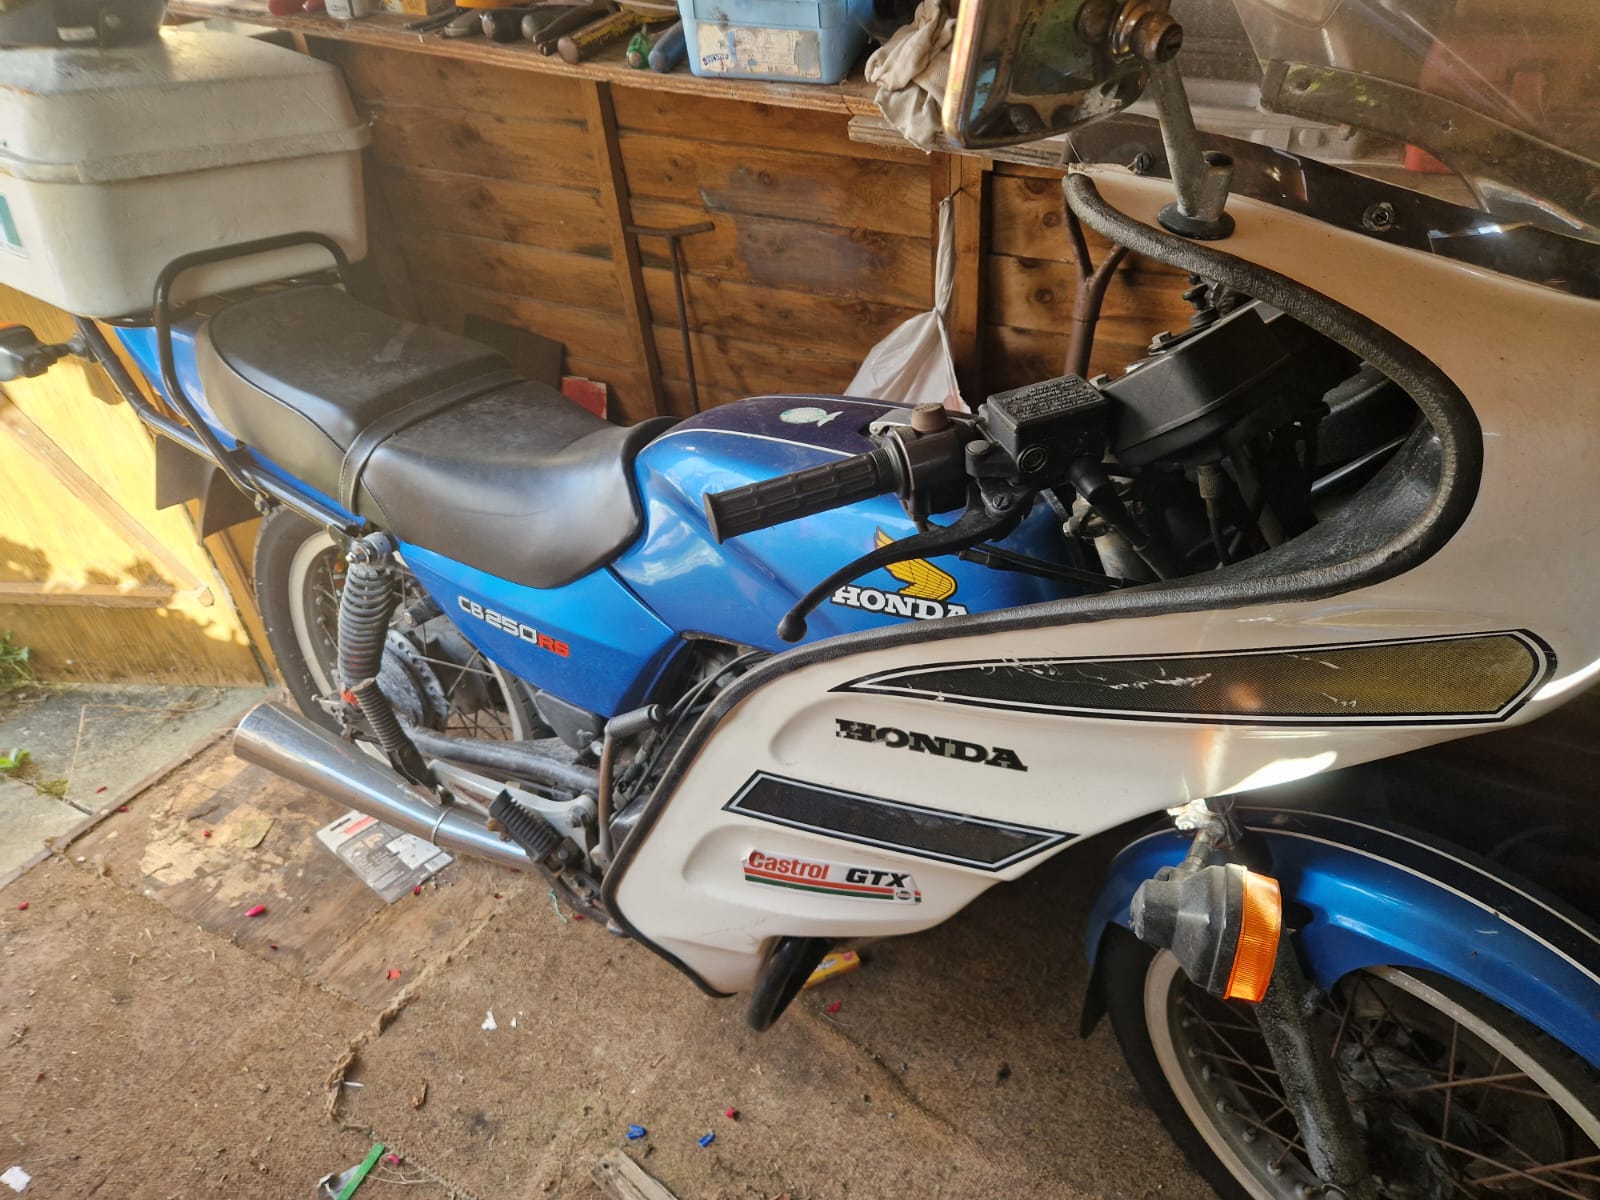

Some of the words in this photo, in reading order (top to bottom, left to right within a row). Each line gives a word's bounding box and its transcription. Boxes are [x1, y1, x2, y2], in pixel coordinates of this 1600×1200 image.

[831, 585, 968, 620] HONDA
[835, 718, 1028, 772] HONDA
[748, 851, 830, 880] Castrol
[846, 867, 910, 888] GTX
